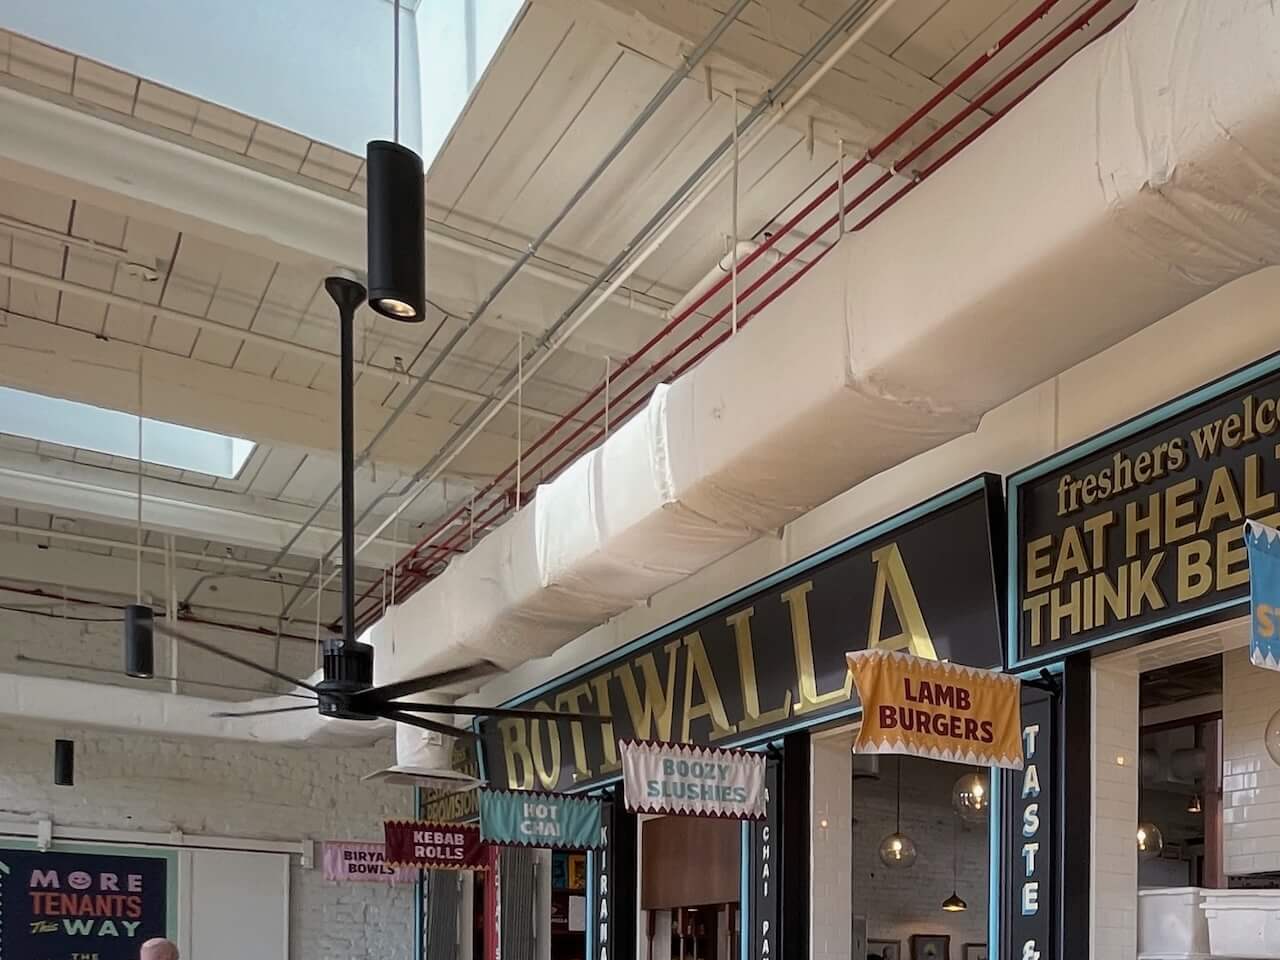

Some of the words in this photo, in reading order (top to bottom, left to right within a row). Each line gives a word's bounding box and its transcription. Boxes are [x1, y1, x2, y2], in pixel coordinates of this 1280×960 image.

[1056, 436, 1186, 517] freshers
[1026, 510, 1114, 594] EAT
[1022, 551, 1166, 647] THINK
[497, 542, 947, 792] BOTIWALLA
[904, 677, 972, 712] LAMB
[878, 704, 994, 744] BURGERS
[662, 758, 730, 783] BOOZY
[646, 780, 748, 804] SLUSHIES
[523, 802, 558, 819] HOT
[1021, 724, 1041, 916] TASTE
[413, 831, 465, 846] KEBAB
[520, 823, 561, 837] CHAI
[344, 851, 387, 863] BIRYA
[414, 845, 465, 860] ROLLS
[762, 826, 770, 897] CHAI
[30, 869, 143, 892] MORE
[348, 863, 395, 875] BOWLS
[29, 892, 143, 918] TENANTS
[63, 919, 141, 937] WAY
[72, 953, 99, 960] THE
